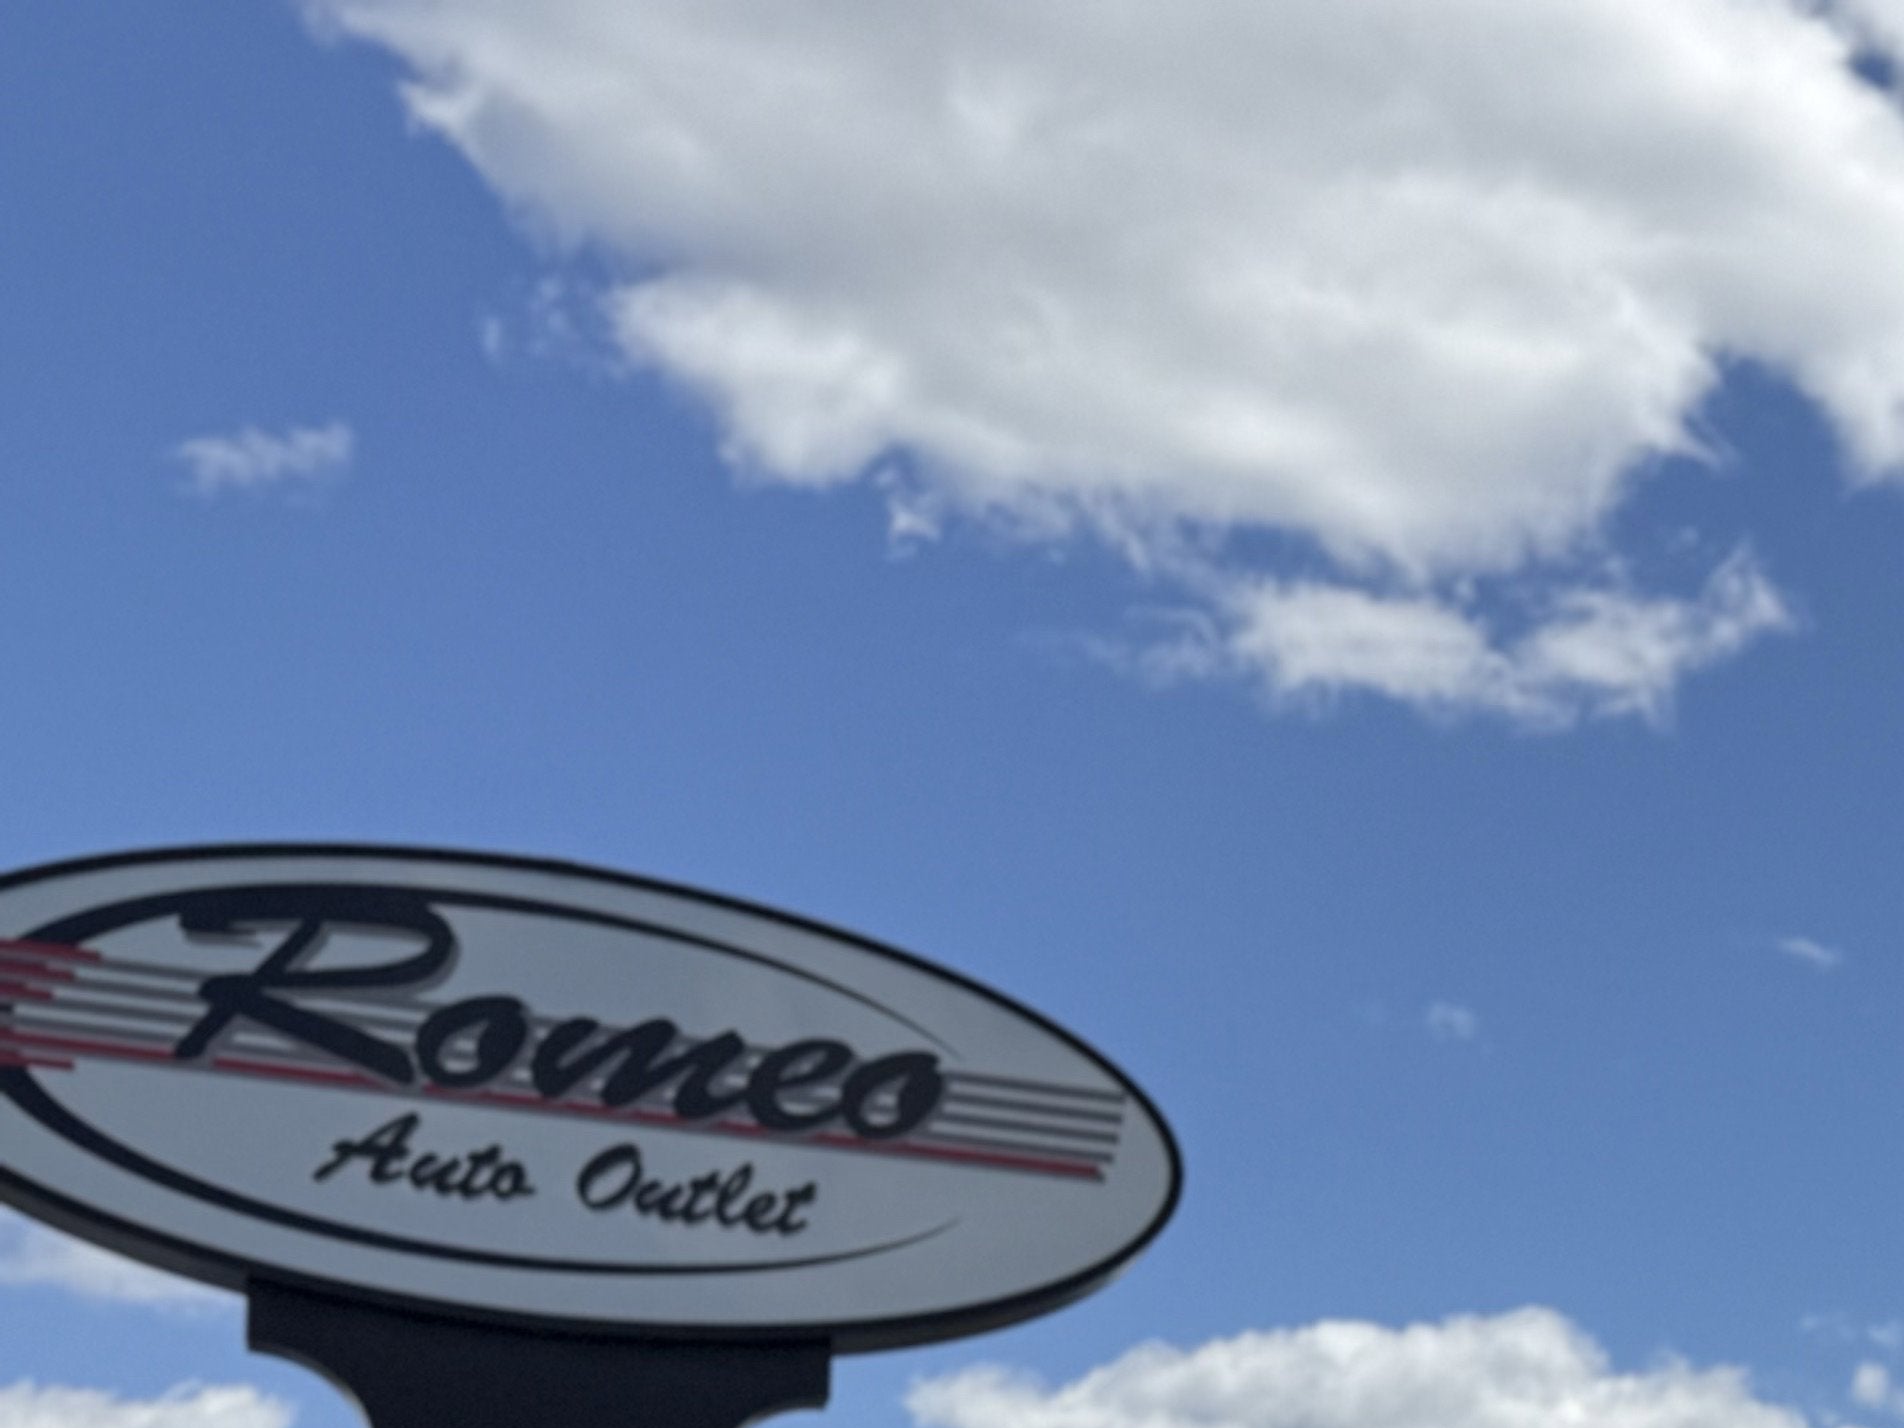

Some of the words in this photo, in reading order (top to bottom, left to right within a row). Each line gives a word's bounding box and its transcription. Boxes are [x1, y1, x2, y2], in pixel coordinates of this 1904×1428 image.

[176, 888, 946, 1141] Romeo
[311, 1112, 536, 1200] Auto
[576, 1142, 817, 1236] Outlet
